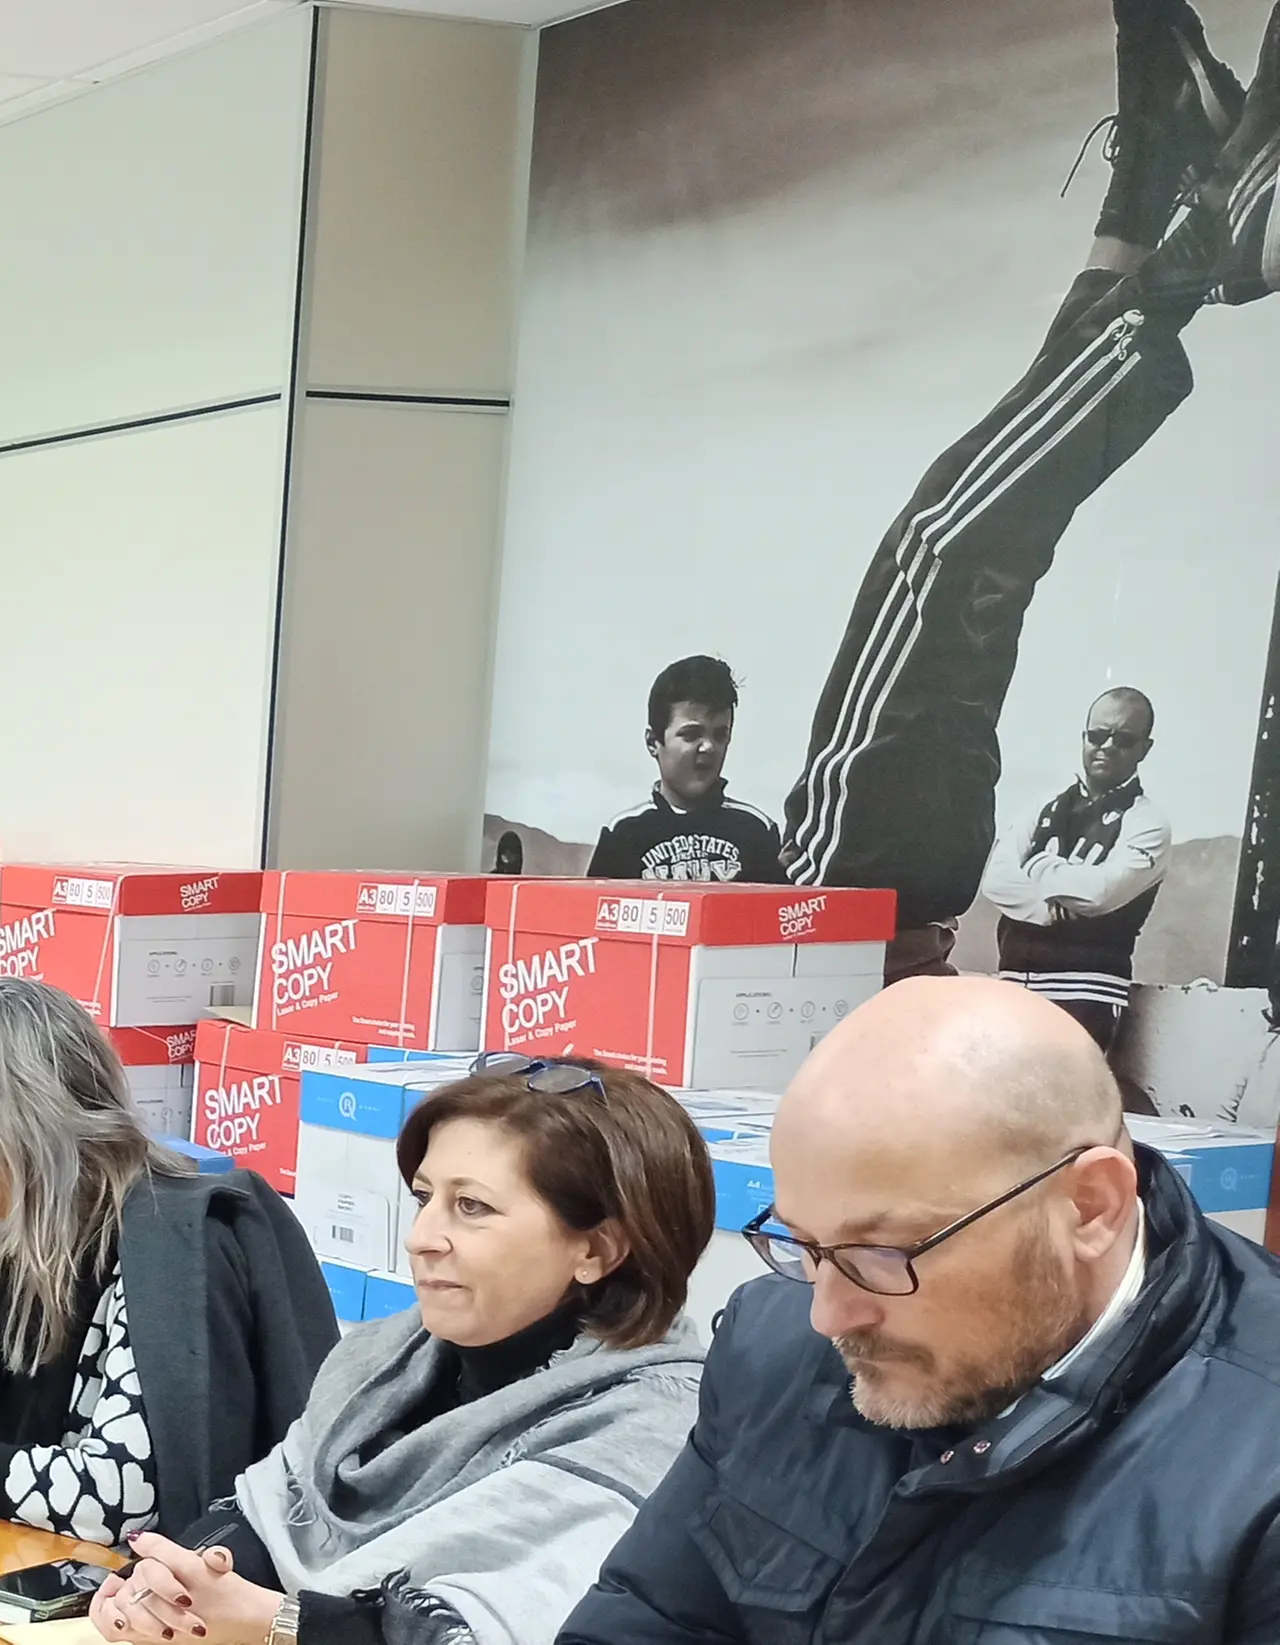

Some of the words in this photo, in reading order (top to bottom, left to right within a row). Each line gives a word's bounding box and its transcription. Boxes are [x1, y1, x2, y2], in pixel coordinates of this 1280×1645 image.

[641, 835, 689, 869] UNITED
[693, 833, 740, 862] STATES
[53, 881, 67, 897] A3
[69, 883, 81, 897] 80
[86, 884, 93, 898] 5
[180, 876, 219, 898] SMART
[358, 888, 377, 906] A3
[379, 890, 395, 906] 80
[403, 891, 411, 906] 5
[416, 892, 434, 908] 500
[181, 892, 209, 909] COPY
[778, 895, 827, 923] SMART
[597, 904, 619, 921] A3
[621, 905, 639, 922] 80
[648, 907, 658, 924] 5
[665, 907, 686, 926] 500
[779, 915, 814, 936] COPY
[271, 918, 359, 974] SMART
[499, 936, 599, 999] SMART
[274, 962, 333, 1005] COPY
[502, 986, 569, 1034] COPY
[554, 1020, 577, 1033] Paper
[166, 1030, 196, 1048] SMAR
[284, 1046, 300, 1063] A3
[302, 1050, 317, 1066] 80
[325, 1053, 332, 1067] 5
[205, 1074, 282, 1121] SMART
[206, 1113, 261, 1150] COPY
[747, 1179, 761, 1189] A4
